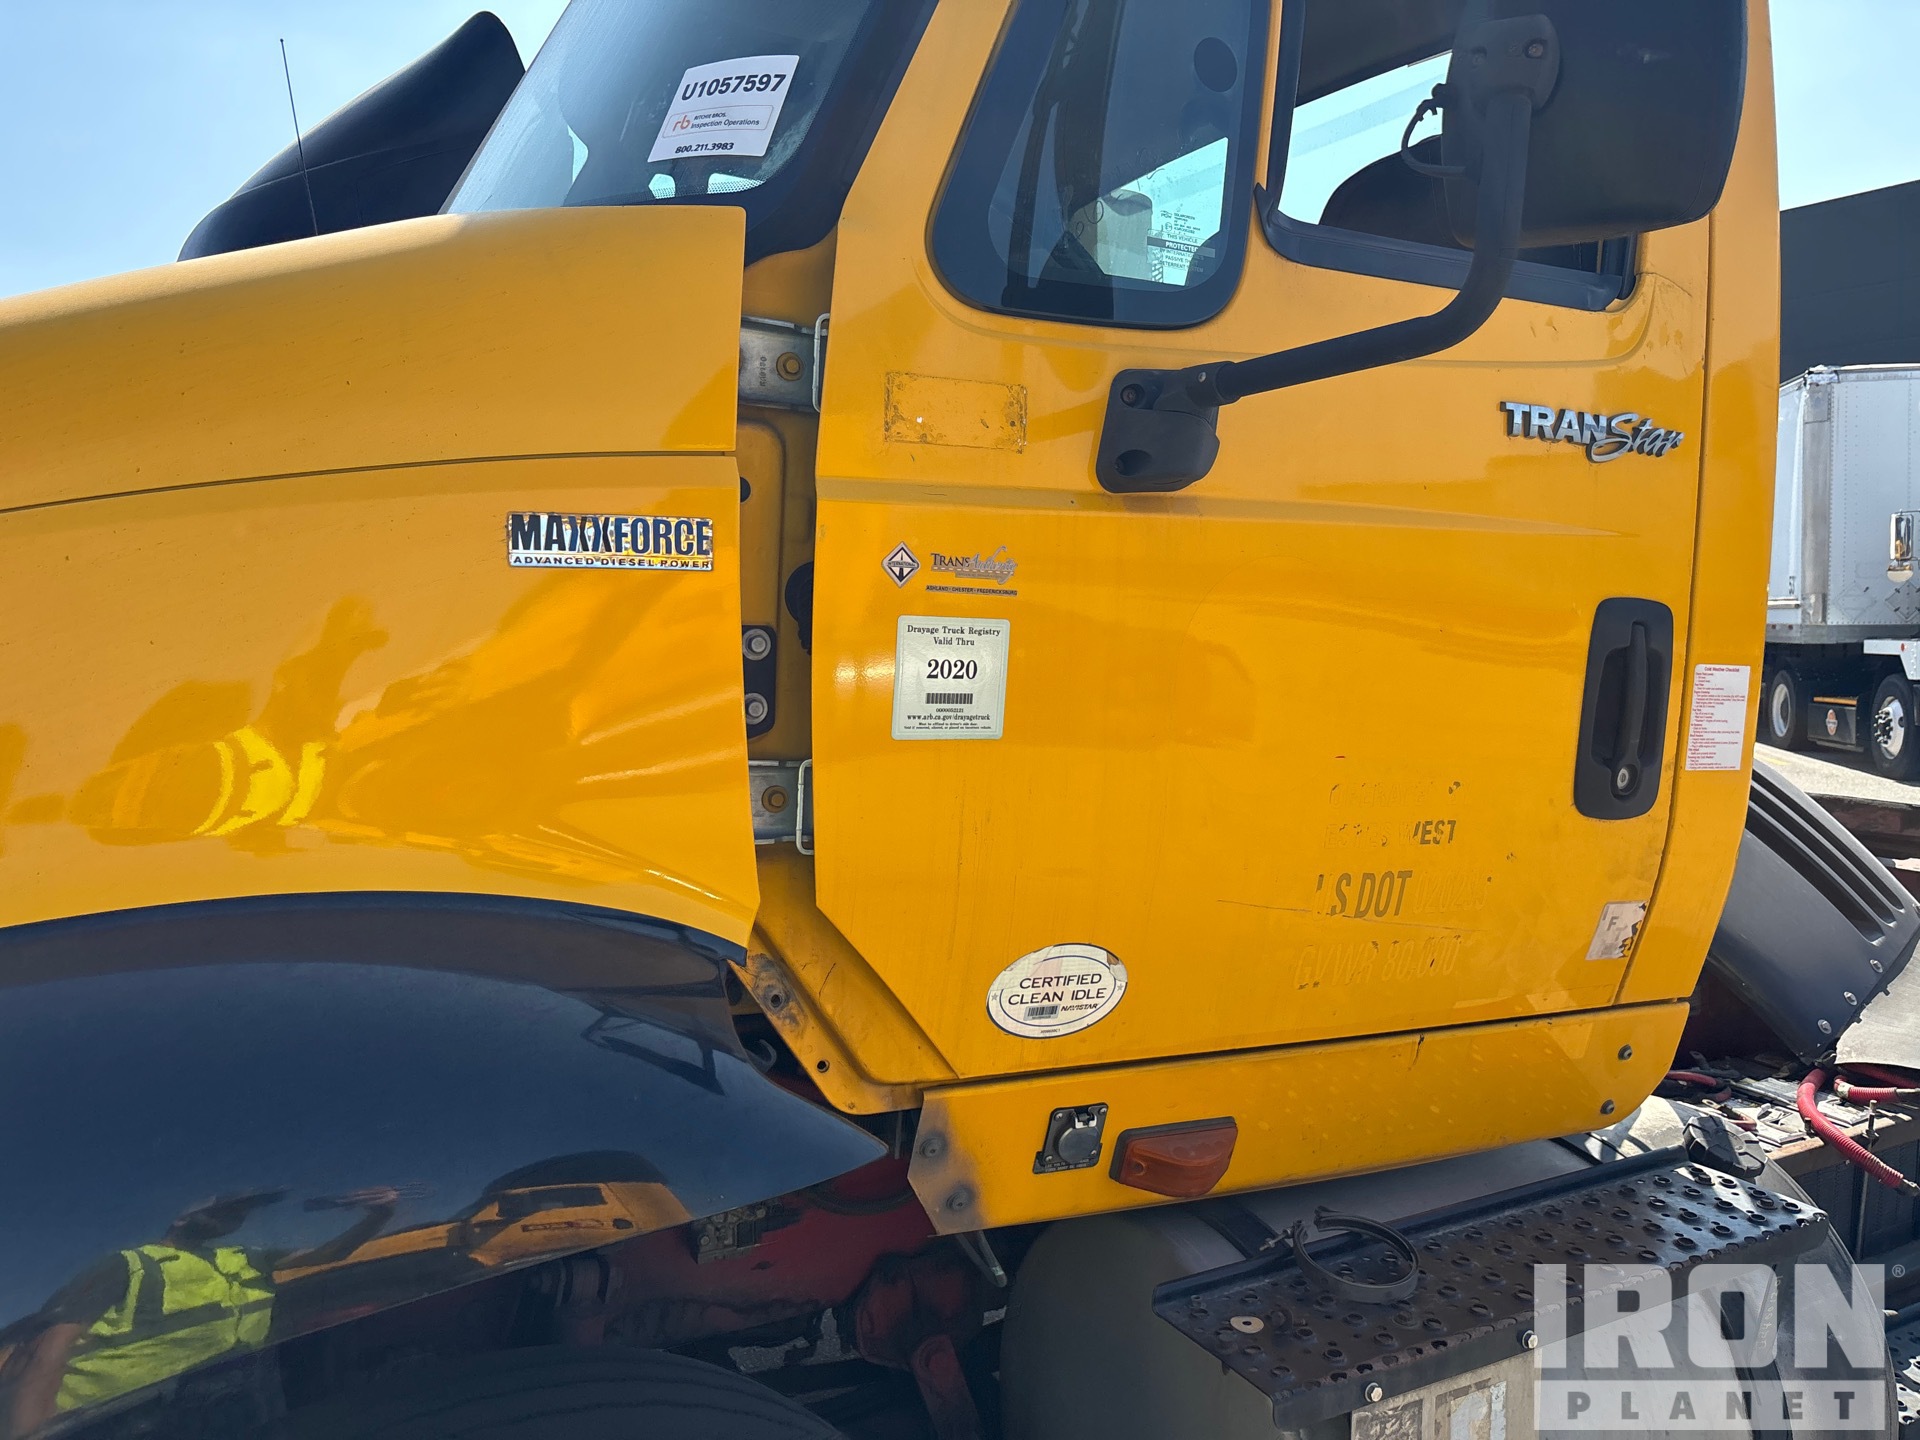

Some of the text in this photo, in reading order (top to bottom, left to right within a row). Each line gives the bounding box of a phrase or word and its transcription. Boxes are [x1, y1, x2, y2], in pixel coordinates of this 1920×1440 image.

[682, 74, 787, 101] U1057597
[691, 121, 722, 129] Inspection
[675, 142, 735, 153] 800.211.3983
[511, 514, 711, 556] MAXXFORCE
[513, 556, 710, 569] ADVANCED DIESEL POWER
[907, 624, 1001, 637] Drayage Truck Registry
[933, 636, 975, 646] Valid Thru
[926, 659, 978, 680] 2020
[907, 713, 991, 721] www.arb.ca.gov/drayagetruck
[1354, 870, 1413, 918] DOT
[1020, 973, 1102, 989] CERTIFIED
[1008, 987, 1107, 1006] CLEAN IDLE
[1060, 1003, 1098, 1012] NAVISTAR
